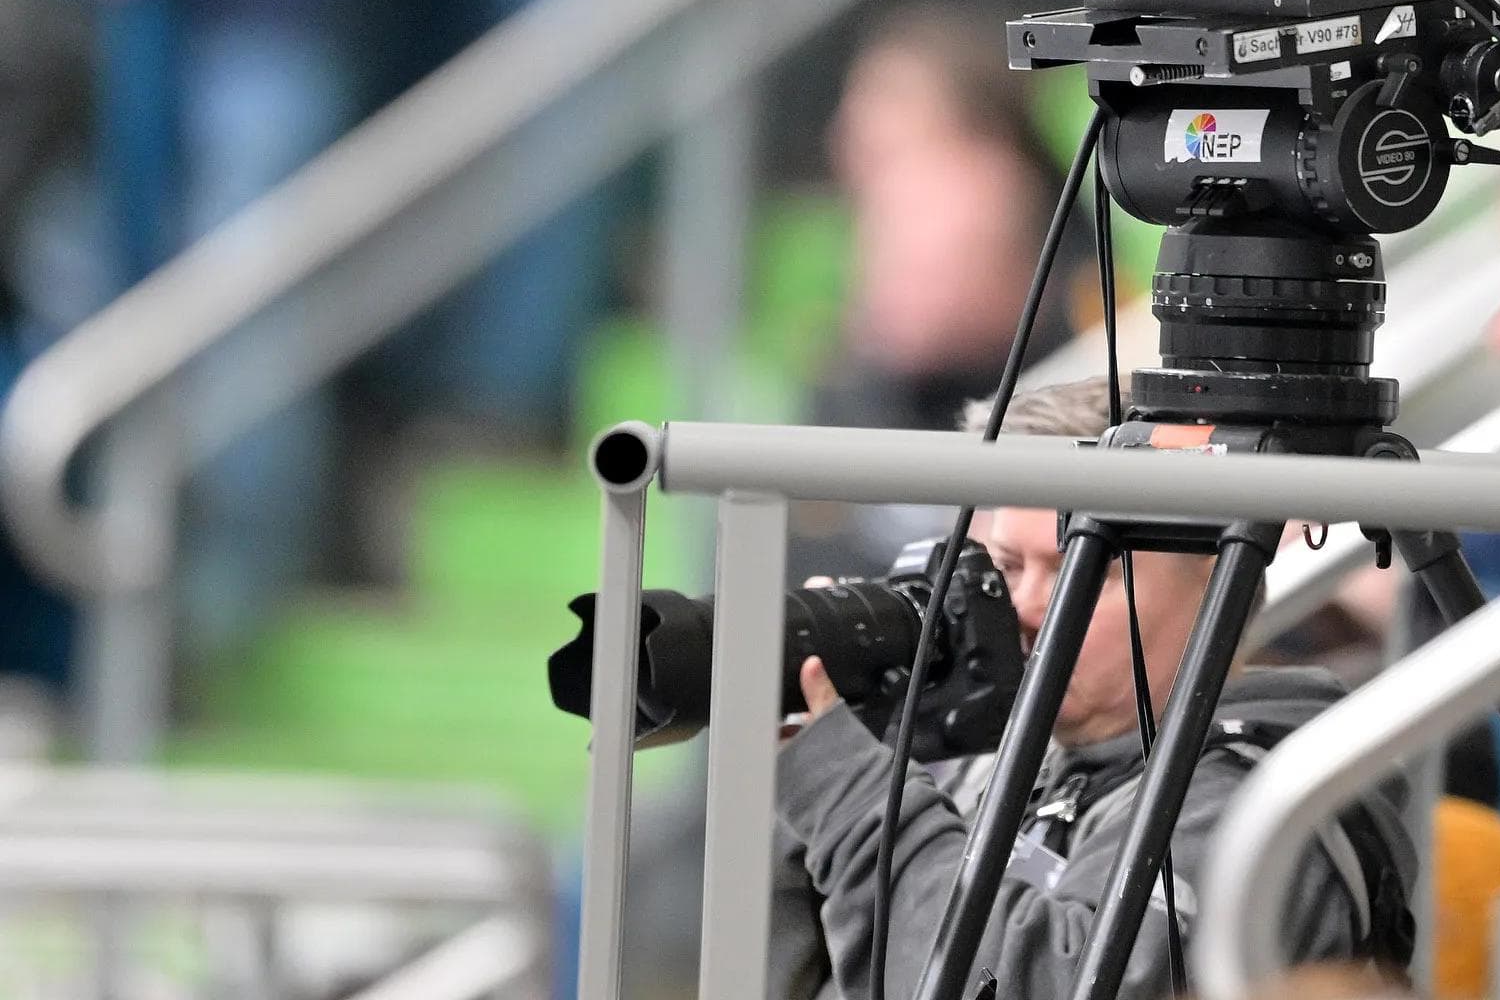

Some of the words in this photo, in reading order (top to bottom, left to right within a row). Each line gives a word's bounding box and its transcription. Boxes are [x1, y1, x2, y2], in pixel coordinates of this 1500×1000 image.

[1306, 29, 1333, 45] V90
[1335, 23, 1359, 41] #78
[1201, 132, 1242, 158] NEP
[1376, 151, 1404, 165] VIDEO
